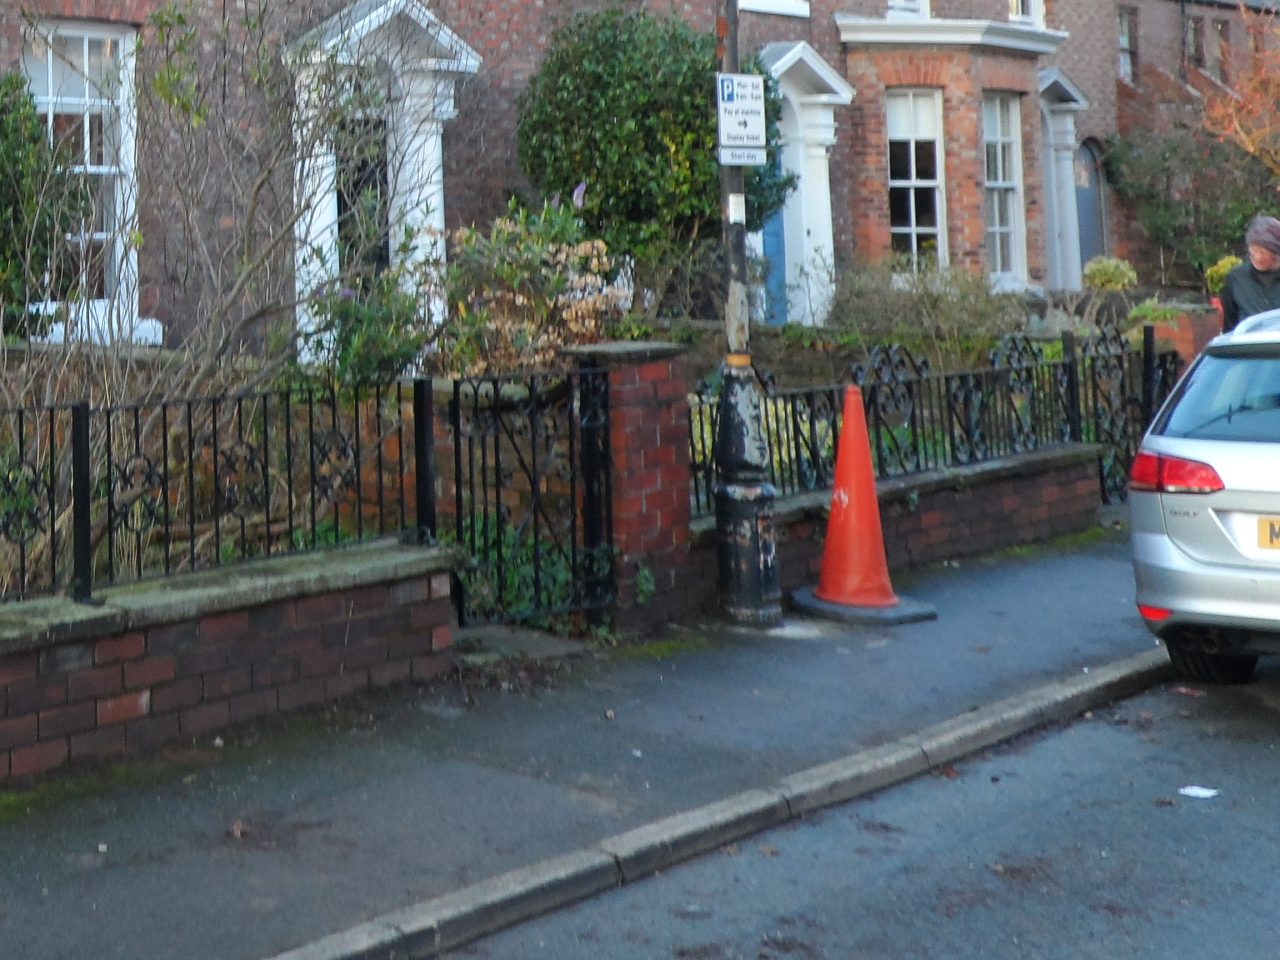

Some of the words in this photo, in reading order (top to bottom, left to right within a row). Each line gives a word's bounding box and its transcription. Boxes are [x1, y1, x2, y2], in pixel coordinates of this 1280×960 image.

[737, 81, 748, 89] Mon
[724, 80, 733, 101] P
[724, 106, 733, 116] Pay
[735, 107, 740, 115] at
[741, 108, 761, 116] machine
[726, 132, 745, 142] Display
[746, 133, 761, 141] ticket
[730, 151, 746, 161] Short
[746, 152, 757, 161] stay
